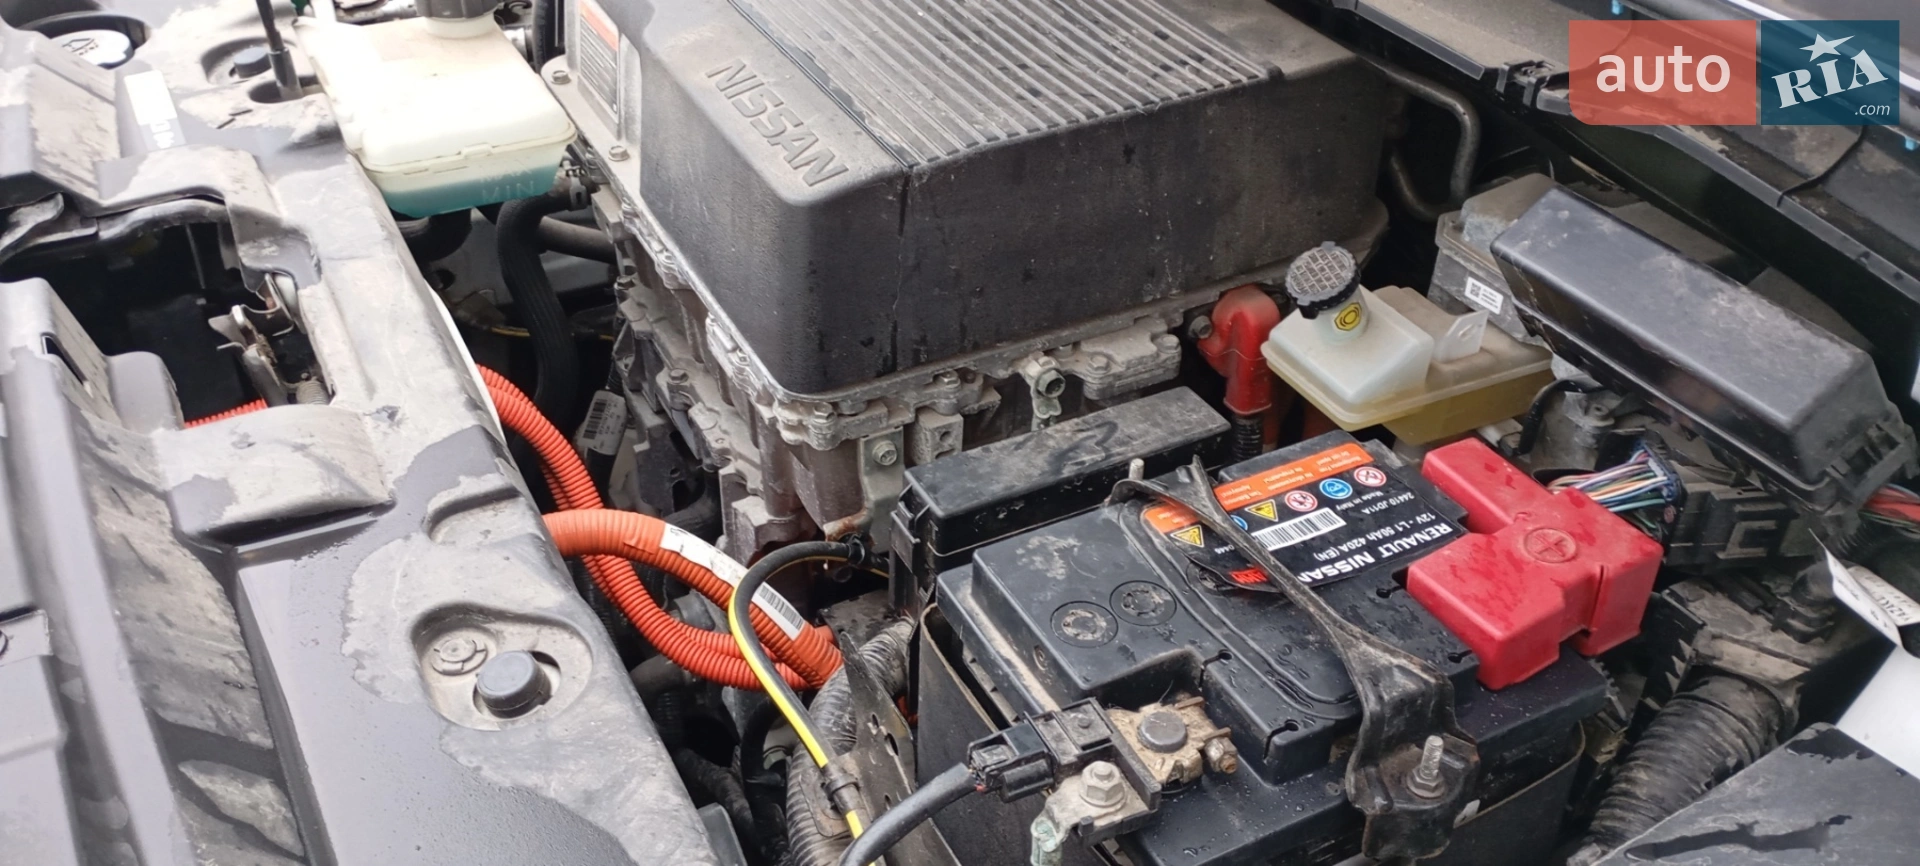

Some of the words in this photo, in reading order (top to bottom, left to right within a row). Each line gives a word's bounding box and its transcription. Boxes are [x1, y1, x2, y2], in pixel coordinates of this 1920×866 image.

[705, 58, 849, 187] NISSAN
[482, 181, 534, 204] MIN
[1415, 512, 1436, 525] 12V
[1365, 527, 1396, 541] 50Ah
[1377, 522, 1454, 558] RENAULT
[1338, 539, 1367, 552] 420A
[1313, 546, 1341, 561] (EN)
